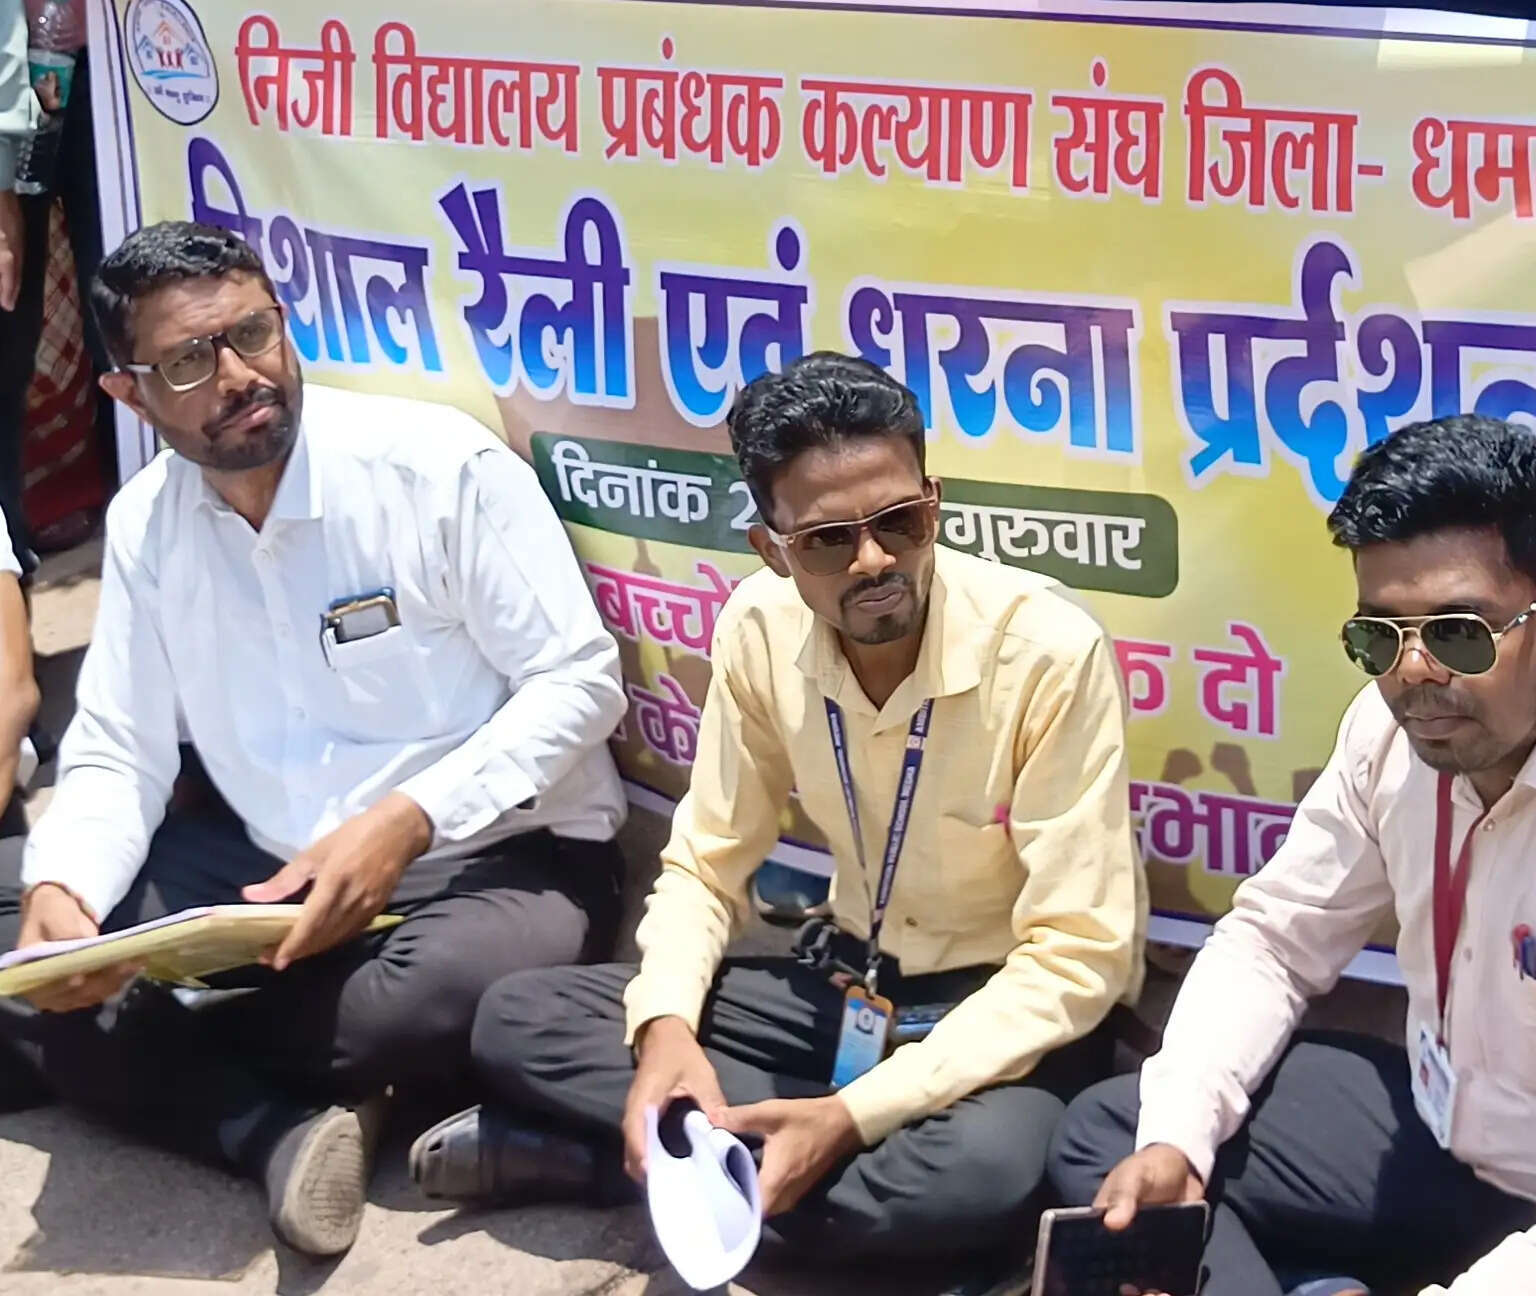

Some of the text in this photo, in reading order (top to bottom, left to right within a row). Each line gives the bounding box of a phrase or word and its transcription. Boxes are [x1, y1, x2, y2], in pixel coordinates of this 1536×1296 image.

[235, 14, 355, 137] निजी
[373, 22, 580, 151] विद्यालय
[598, 38, 782, 168] प्रबंधक
[800, 78, 1033, 189] कल्याण
[1054, 61, 1163, 198] संघ
[439, 182, 629, 397] रैली
[662, 226, 806, 418] एवं
[849, 284, 1134, 452] धरना
[551, 441, 1145, 570] दिनांक 2 गुरुवार
[1194, 624, 1282, 735] दो
